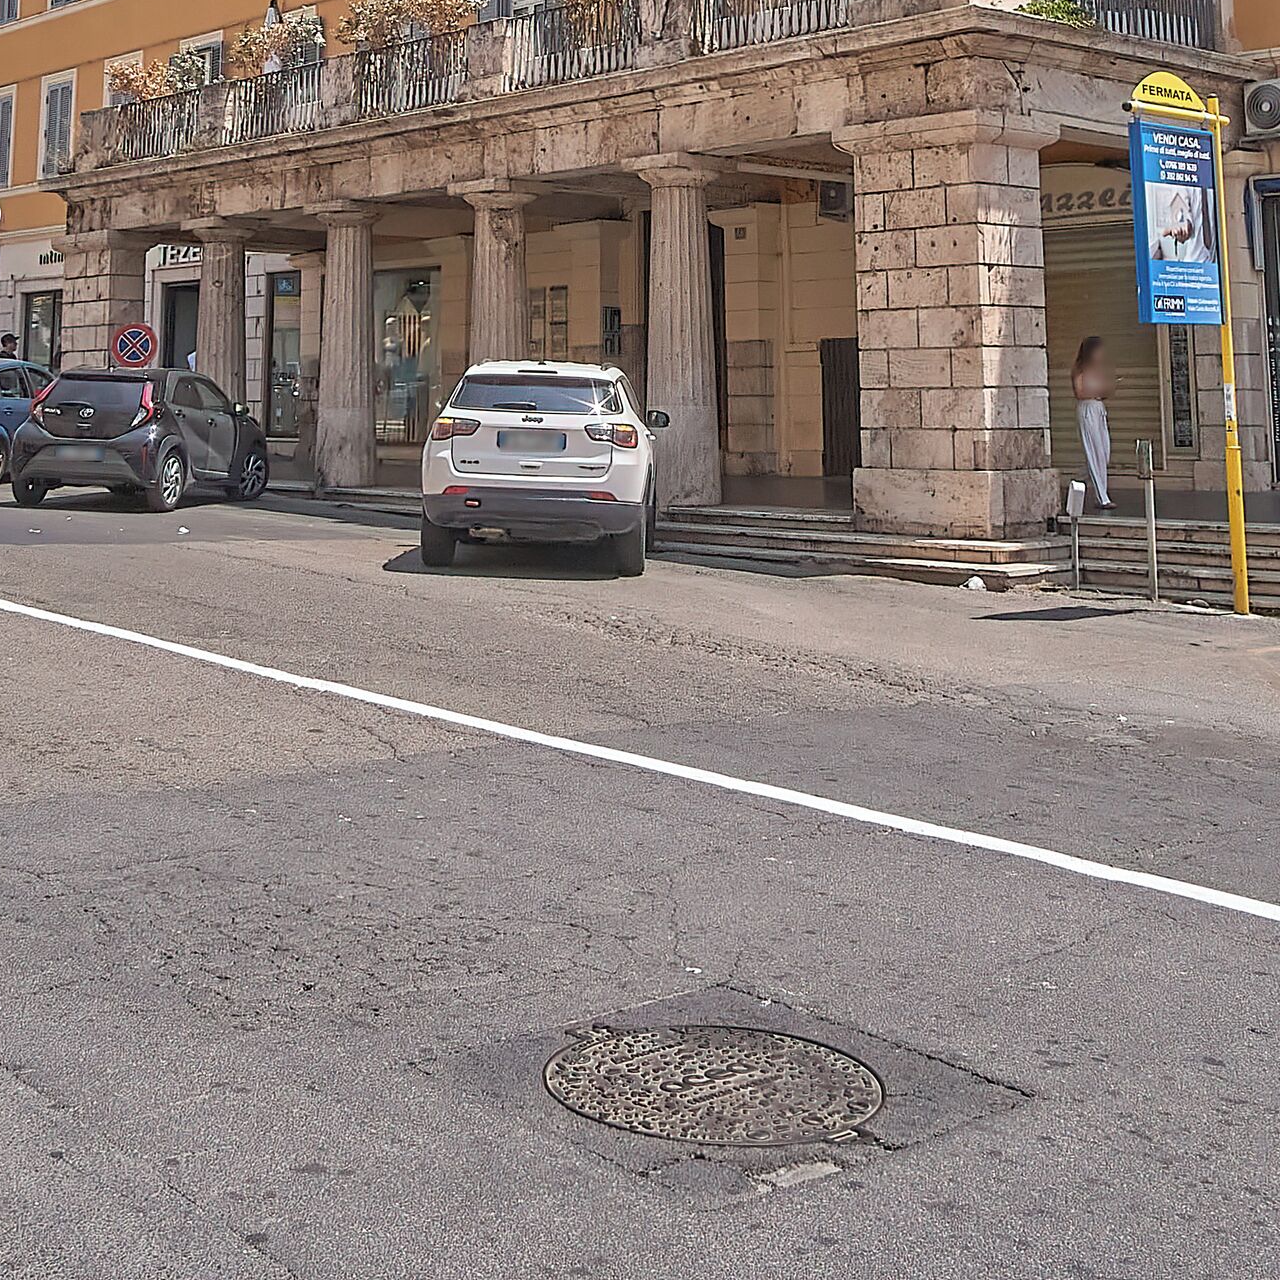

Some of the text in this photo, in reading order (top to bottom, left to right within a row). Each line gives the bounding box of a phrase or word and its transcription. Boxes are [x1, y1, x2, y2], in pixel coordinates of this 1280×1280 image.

[1142, 84, 1193, 103] FERMATA
[1153, 131, 1177, 146] VENDI
[158, 245, 203, 265] TEZE
[521, 415, 544, 424] Jeep
